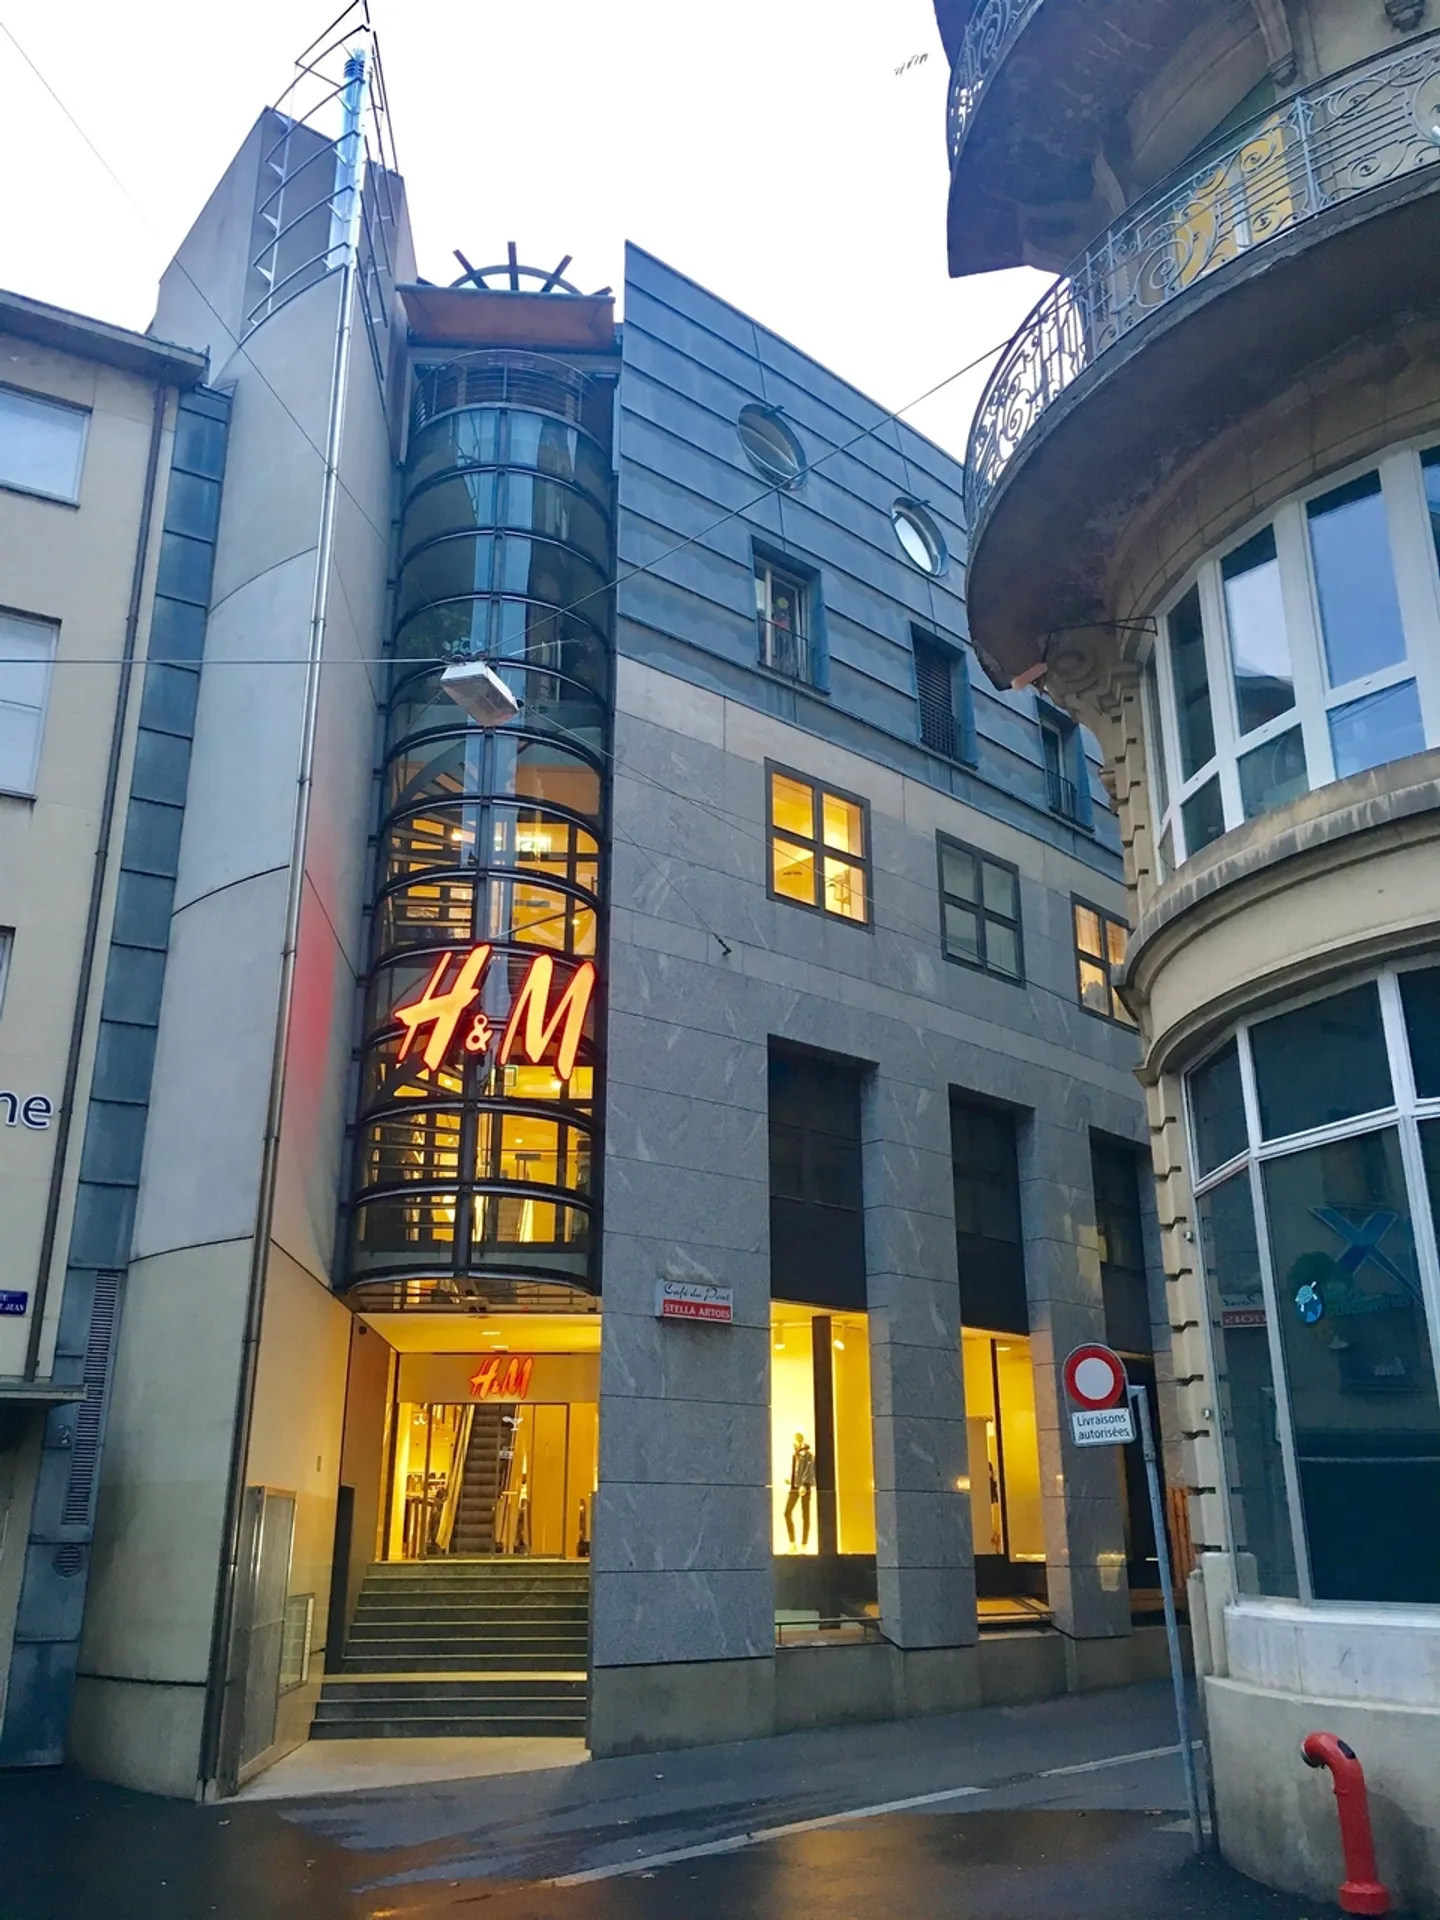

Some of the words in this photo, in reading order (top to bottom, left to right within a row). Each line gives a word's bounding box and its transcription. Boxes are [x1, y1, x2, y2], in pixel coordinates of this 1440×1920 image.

[394, 943, 596, 1081] H&M
[664, 1282, 688, 1299] Café
[690, 1288, 702, 1298] du
[704, 1286, 730, 1302] Pont
[664, 1303, 696, 1315] STELLA
[698, 1307, 730, 1318] ARTOIS
[468, 1356, 533, 1400] H&M
[1077, 1413, 1126, 1427] Livraisons
[1078, 1426, 1129, 1440] autorisées
